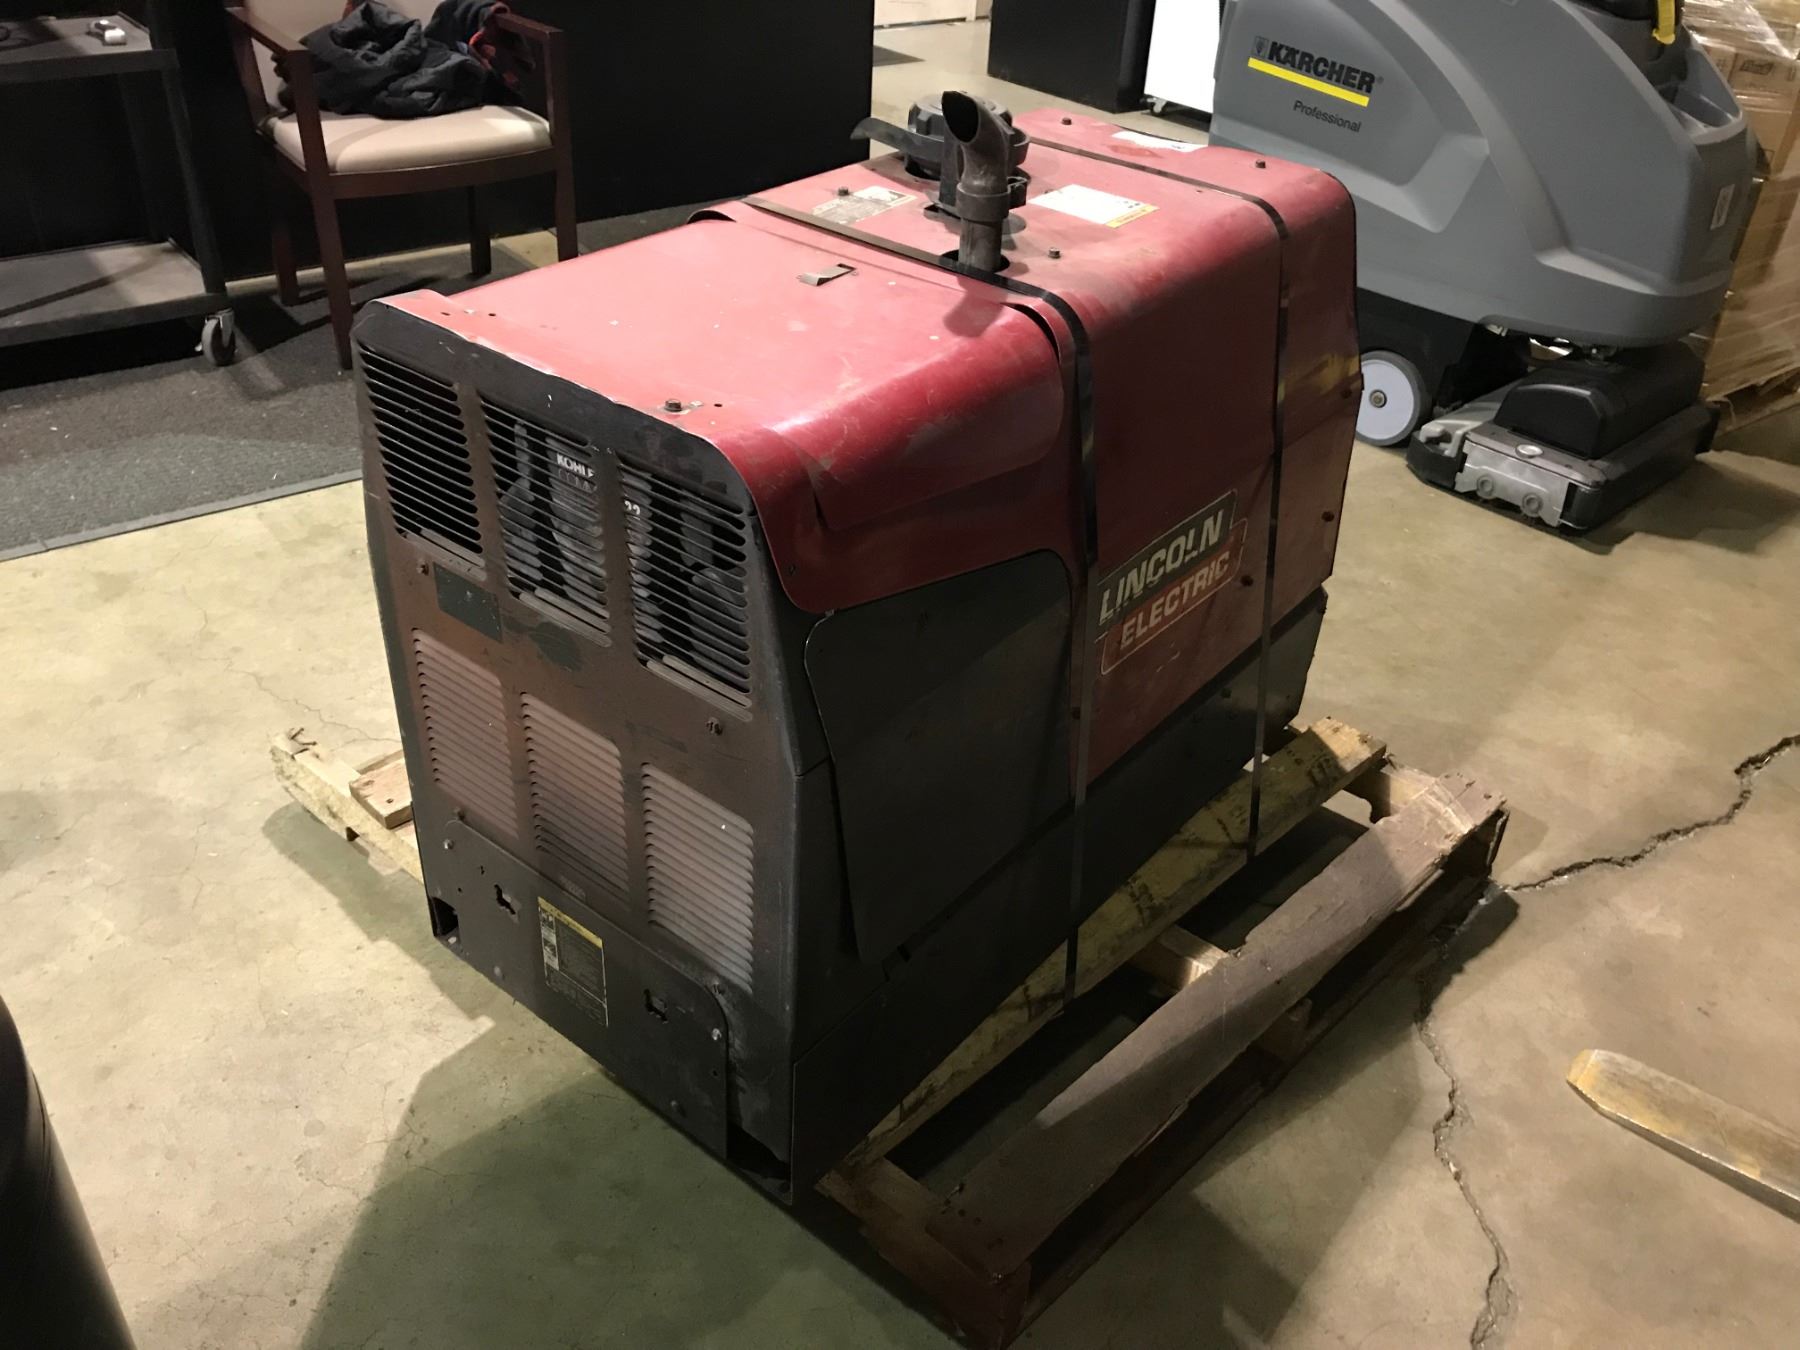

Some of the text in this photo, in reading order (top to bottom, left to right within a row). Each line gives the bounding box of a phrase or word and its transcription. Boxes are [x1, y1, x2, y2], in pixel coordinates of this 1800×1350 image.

[1267, 41, 1375, 93] KÄRCHER
[1293, 100, 1362, 133] Professional
[1099, 509, 1225, 627] LINCOLN
[1120, 551, 1230, 651] ELECTRIC
